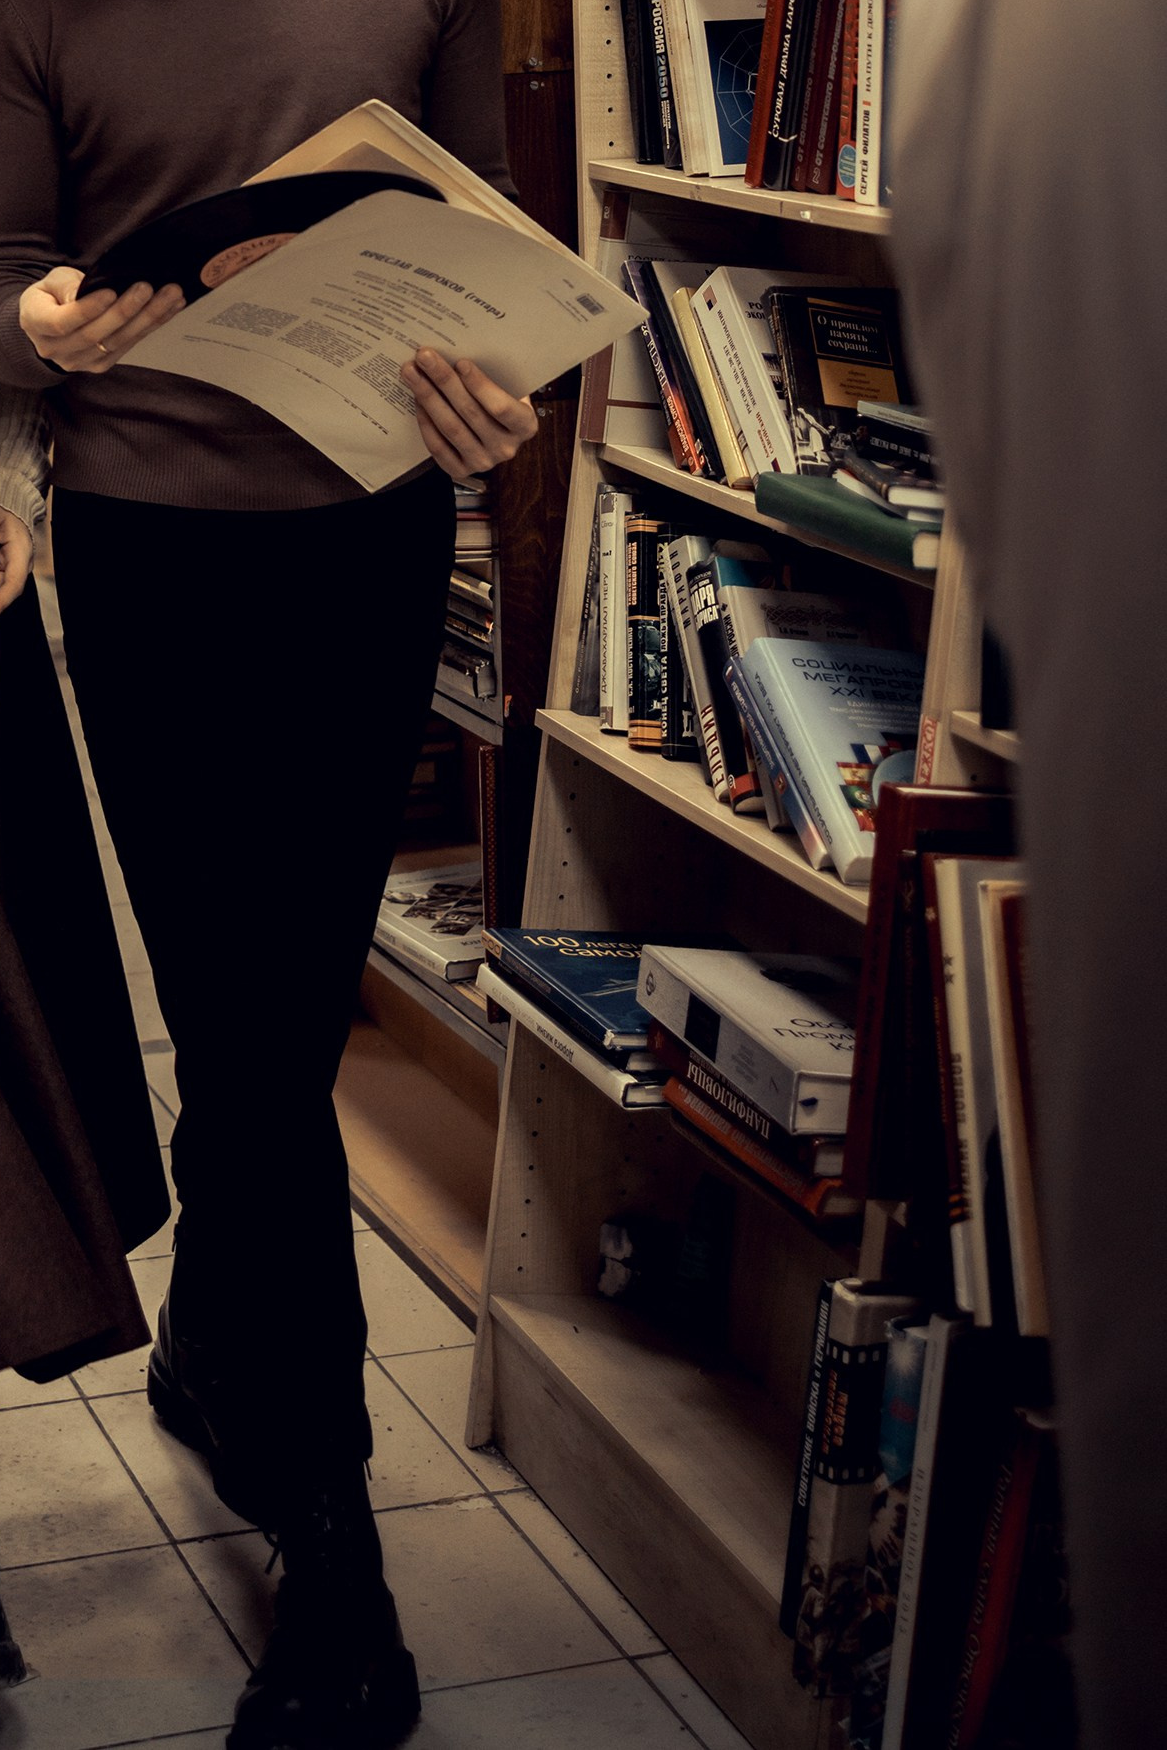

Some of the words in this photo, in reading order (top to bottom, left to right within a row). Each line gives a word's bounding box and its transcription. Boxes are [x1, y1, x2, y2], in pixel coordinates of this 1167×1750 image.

[866, 31, 872, 39] К
[656, 54, 669, 99] 2050
[770, 80, 785, 138] СУРОВАЯ
[778, 32, 792, 78] ДРАМА
[865, 75, 871, 92] НА
[797, 76, 814, 144] СОВЕТСКОГО
[816, 81, 834, 149] СОВЕТСКОГО
[861, 109, 870, 154] ФИЛАТОВ
[813, 149, 823, 165] ОТ
[858, 159, 868, 195] СЕРГЕЙ
[413, 265, 466, 296] ШИРОКОВ
[465, 290, 507, 321] (гитара)
[715, 308, 737, 352] ДИПЛОМАТИИ
[817, 314, 827, 325] О
[829, 318, 880, 335] прошлом
[829, 327, 869, 343] память
[646, 337, 669, 391] ТЕКСТЫ
[731, 350, 757, 406] ЭКОНОМИЧЕСКОЙ
[659, 581, 667, 615] ПРАВДА
[668, 549, 693, 629] МАРАФОН
[719, 613, 739, 644] РОССИИ
[729, 679, 749, 713] СТОЛИЦЫ
[752, 670, 769, 698] ВЕКА
[829, 686, 864, 699] XXI
[698, 703, 727, 787] ЕЛЬЦИН
[523, 934, 581, 949] 100
[532, 1022, 554, 1042] жизни
[549, 1036, 577, 1062] Дорога
[679, 1057, 777, 1141] ПАНФИЛОВЦЫ
[812, 1298, 830, 1367] ГЕРМАНИИ
[805, 1379, 821, 1432] ВОЙСКА
[796, 1433, 815, 1506] СОВЕТСКИЕ
[902, 1468, 927, 1584] ИЗБРАННОЕ
[982, 1464, 1014, 1553] Ратная
[969, 1561, 994, 1626] слава
